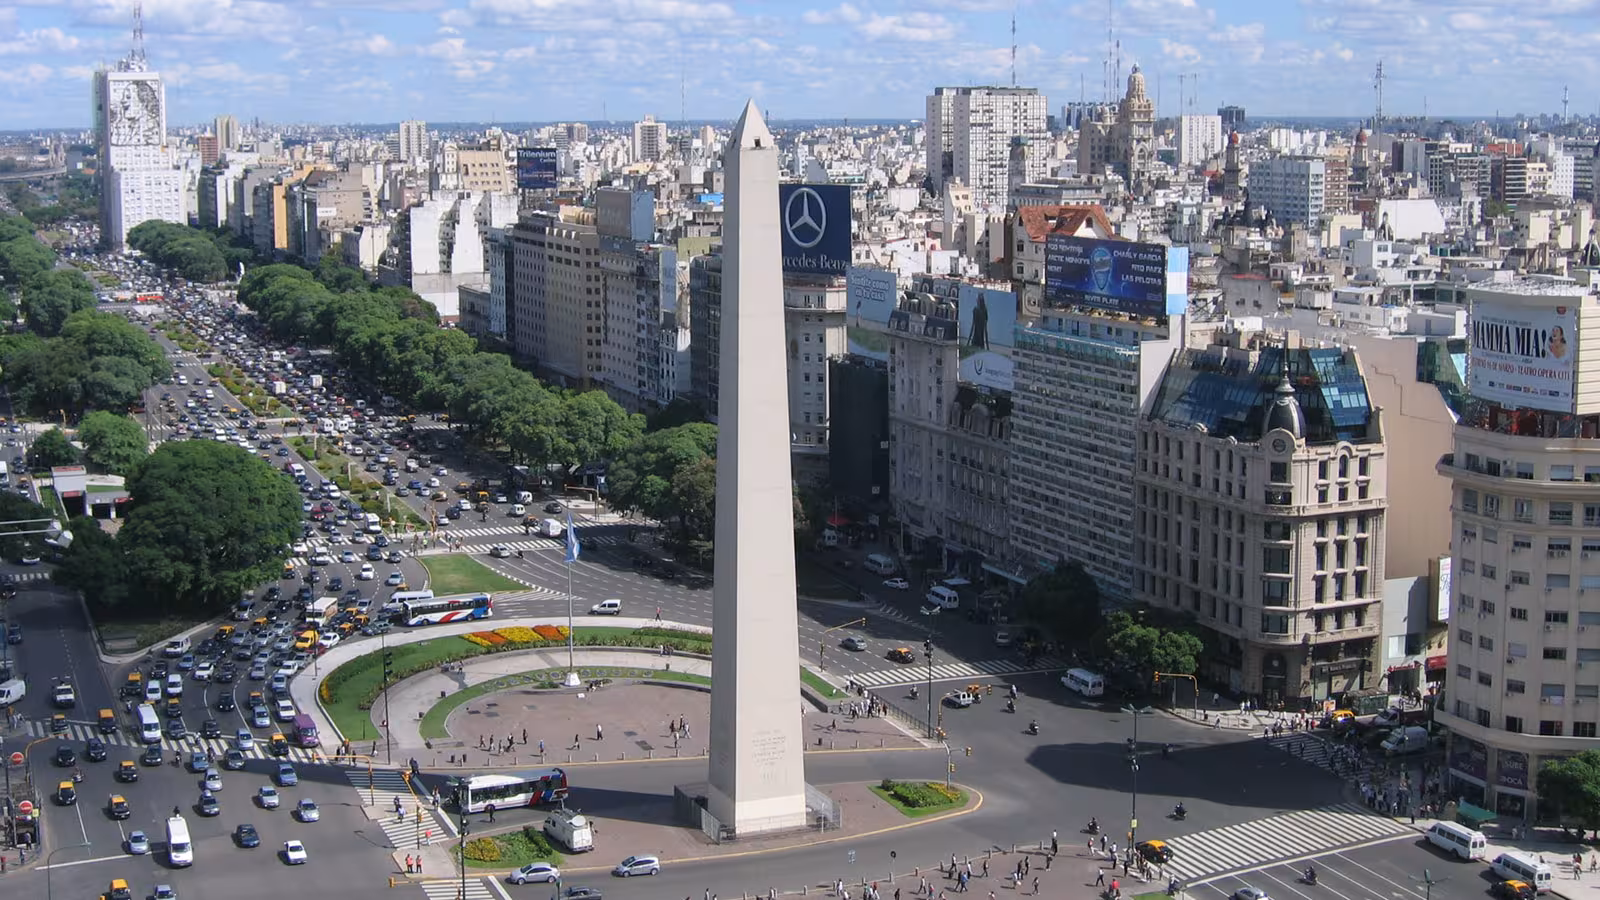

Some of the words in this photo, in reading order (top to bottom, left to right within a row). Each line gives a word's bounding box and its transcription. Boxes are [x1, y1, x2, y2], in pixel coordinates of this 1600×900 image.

[518, 150, 556, 158] Trilenium
[783, 253, 847, 270] rcedes-Benz
[1473, 320, 1512, 354] MAMMA
[1515, 327, 1547, 358] MIA!
